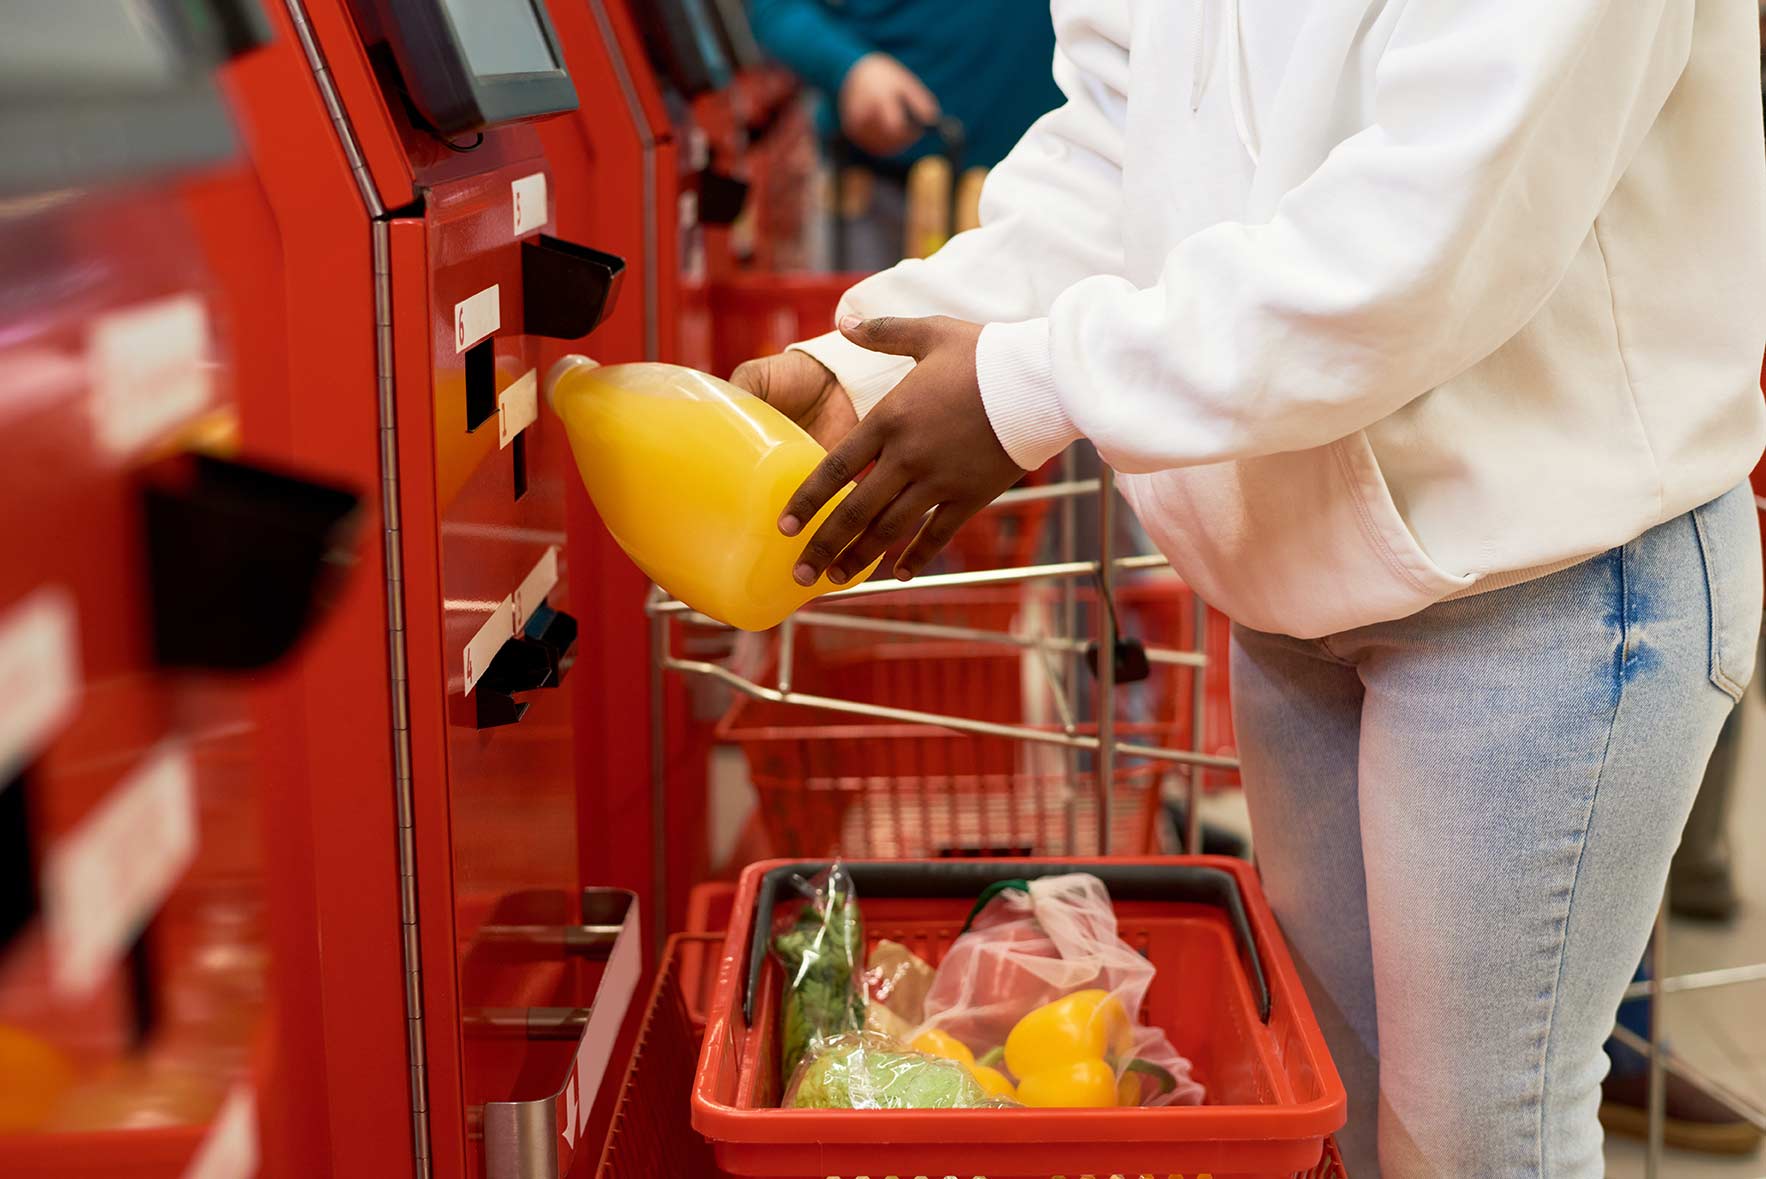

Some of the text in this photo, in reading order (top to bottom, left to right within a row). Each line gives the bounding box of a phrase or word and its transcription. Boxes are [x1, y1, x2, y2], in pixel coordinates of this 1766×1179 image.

[458, 306, 465, 346] 6
[501, 402, 507, 437] 1
[466, 647, 472, 683] 4
